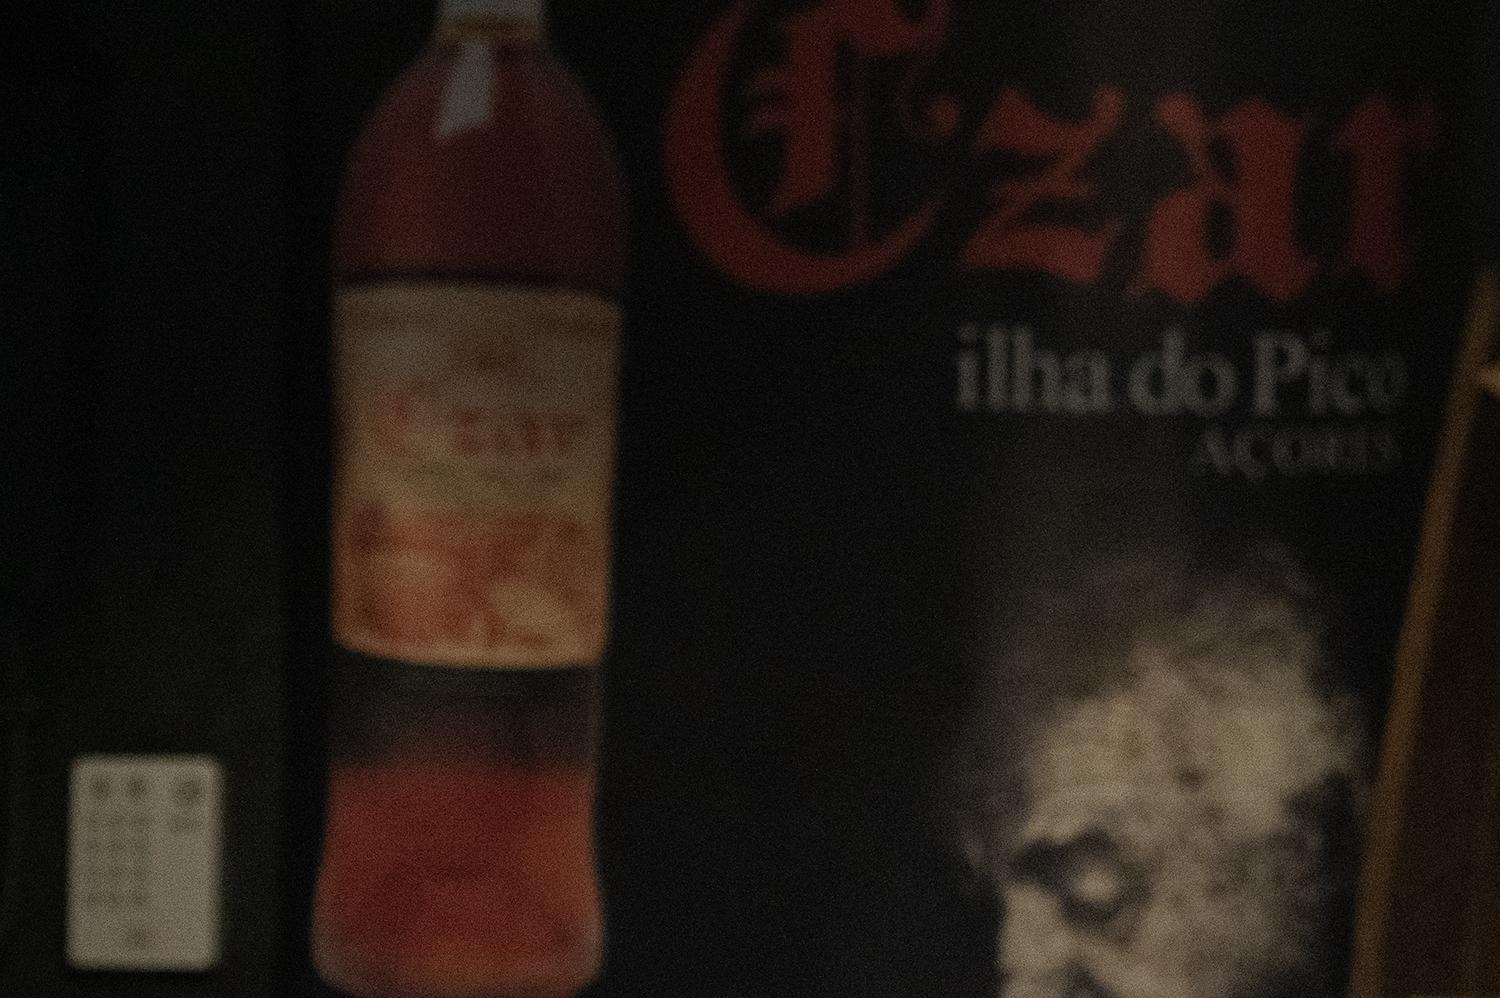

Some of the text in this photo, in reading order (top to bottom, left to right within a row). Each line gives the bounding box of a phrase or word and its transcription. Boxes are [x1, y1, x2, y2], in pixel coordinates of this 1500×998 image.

[659, 0, 1440, 303] Czar
[955, 321, 1409, 416] ilha do Pico
